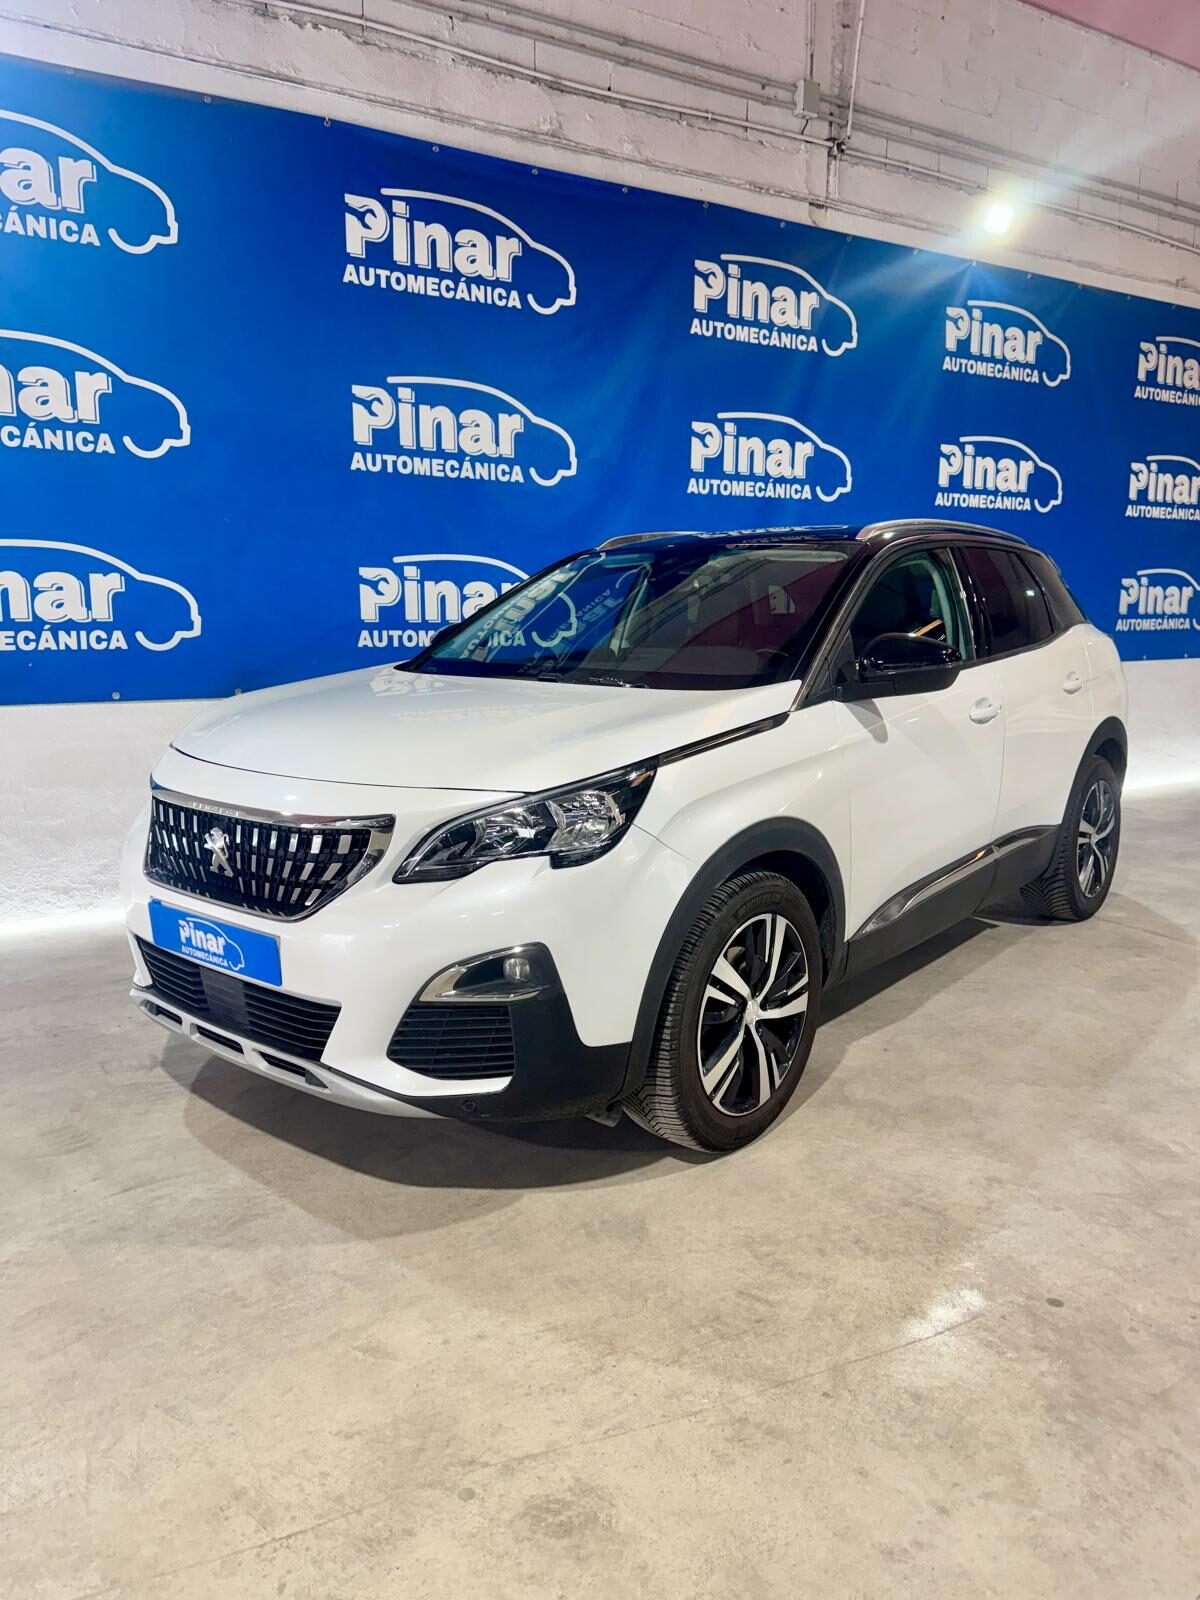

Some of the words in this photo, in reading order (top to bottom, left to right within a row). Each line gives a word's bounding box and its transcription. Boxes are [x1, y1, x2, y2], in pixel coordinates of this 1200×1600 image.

[0, 205, 101, 247] ÁNICA
[344, 193, 523, 283] Pinar
[342, 264, 523, 309] AUTOMECÁNICA
[693, 259, 820, 331] Pinar
[689, 318, 818, 353] AUTOMECÁNICA
[945, 306, 1043, 364] Pinar
[942, 357, 1040, 384] AUTOMECÁNICA
[0, 364, 113, 425] ar
[1134, 386, 1200, 406] AUTOMECÁNI
[0, 422, 116, 454] CÁNICA
[351, 384, 525, 459] Pinar
[350, 451, 525, 483] AUTOMECÁNICA
[690, 421, 816, 479] Pinar
[938, 443, 1035, 493] Pinar
[686, 477, 812, 501] AUTOMECÁNICA
[934, 492, 1031, 511] AUTOMECÁNICA
[1128, 462, 1200, 505] Pinar
[1125, 504, 1200, 520] AUTOMECÁNICA
[1118, 576, 1194, 615] Pinar
[0, 625, 129, 651] ECÁNICA
[1115, 615, 1191, 631] AUTOMECÁNICA
[177, 919, 226, 956] Pinar
